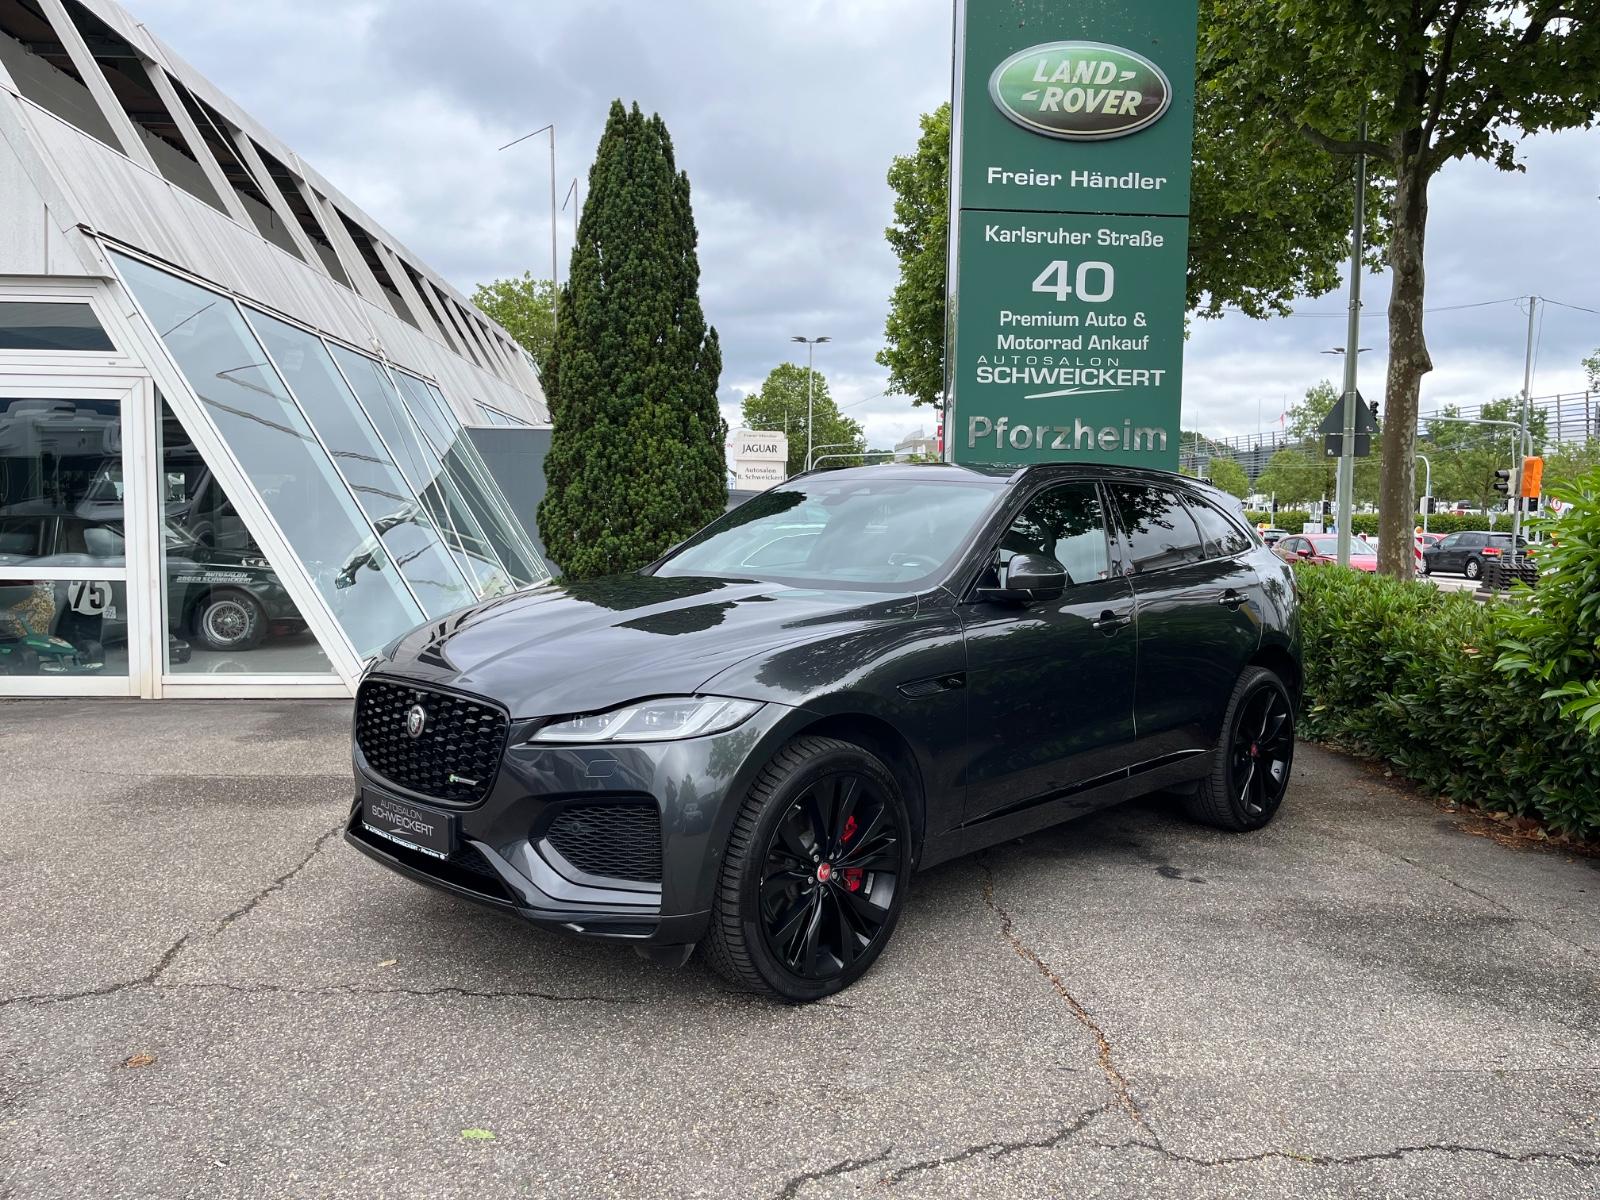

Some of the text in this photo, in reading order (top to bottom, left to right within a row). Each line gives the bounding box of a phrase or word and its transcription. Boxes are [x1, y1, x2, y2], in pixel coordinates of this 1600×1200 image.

[1032, 60, 1117, 85] LAND
[1039, 87, 1142, 116] ROVER
[987, 166, 1167, 190] Freier Händler
[985, 225, 1164, 248] Karlsruher Straße
[1031, 260, 1115, 303] 40
[1000, 310, 1147, 327] Premium Auto &
[997, 334, 1149, 351] Motorrad Ankauf
[977, 355, 1119, 367] AUTOSALON
[976, 366, 1166, 387] SCHWEICKERT
[967, 415, 1167, 451] Pforzheim
[742, 444, 778, 454] JAGUAR
[72, 580, 106, 609] 75
[371, 804, 434, 837] SCHWEICKERT
[380, 799, 423, 821] AUTOSALON
